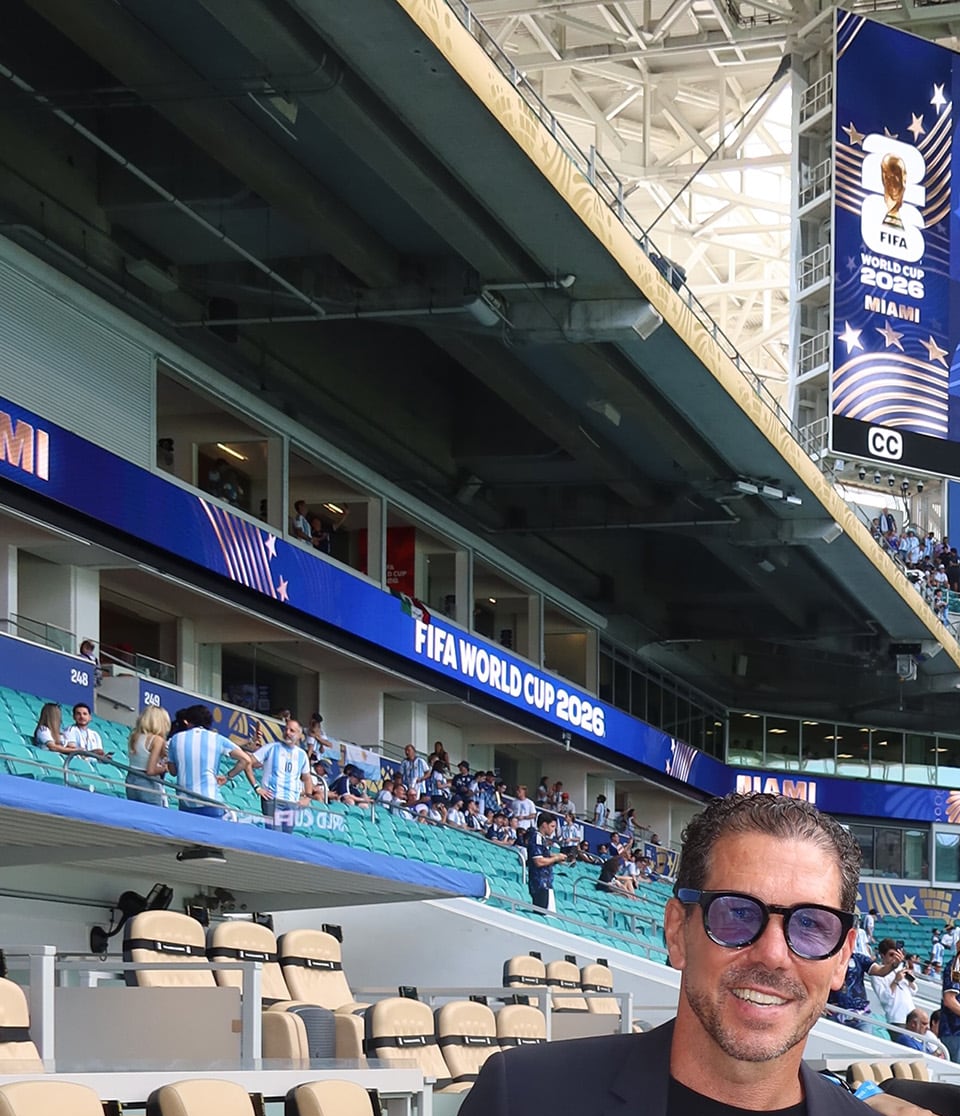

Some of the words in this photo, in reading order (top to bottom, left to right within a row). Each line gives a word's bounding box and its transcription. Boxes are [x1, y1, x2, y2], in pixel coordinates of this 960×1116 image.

[880, 231, 908, 250] FIFA
[861, 252, 901, 274] WORLD
[902, 265, 925, 280] CUP
[860, 266, 925, 299] 2026
[864, 294, 920, 323] MIAMI
[872, 432, 899, 456] CC
[70, 668, 88, 686] 248
[415, 619, 458, 670] FIFA
[459, 638, 522, 698] WORLD
[524, 672, 554, 713] CUP
[556, 689, 605, 737] 2026
[144, 691, 160, 707] 249
